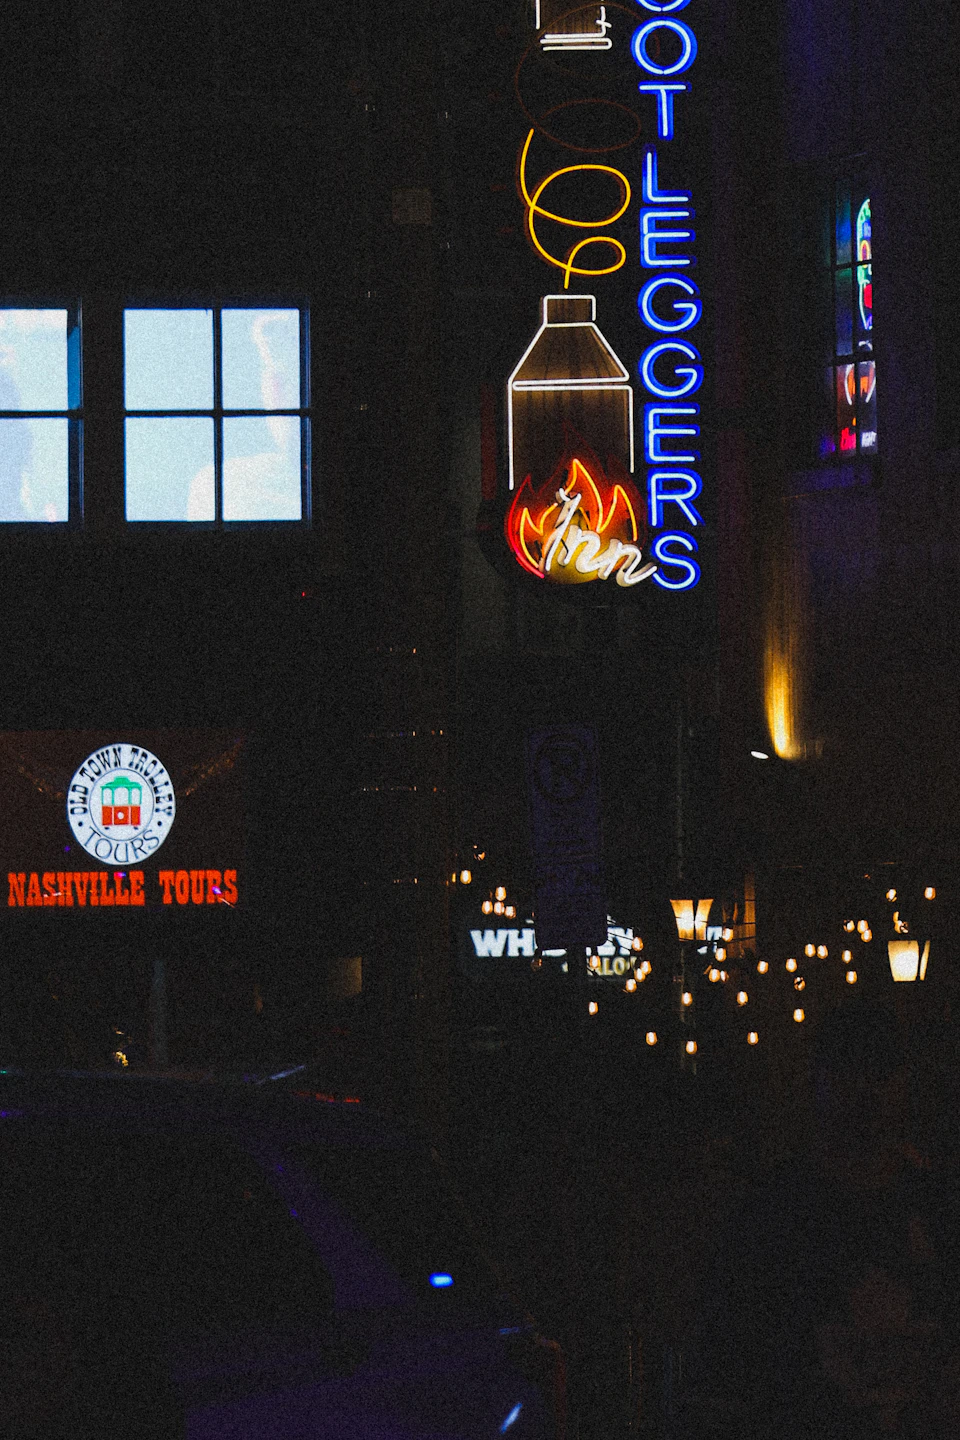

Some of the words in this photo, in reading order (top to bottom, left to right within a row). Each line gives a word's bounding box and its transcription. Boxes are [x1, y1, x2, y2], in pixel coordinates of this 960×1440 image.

[537, 487, 658, 587] Inn
[69, 784, 88, 816] OLD
[79, 746, 122, 782] TOWN
[128, 747, 173, 817] TROLLEY
[84, 825, 160, 863] TOURS
[8, 871, 146, 907] NASHVILLE
[158, 869, 239, 906] TOURS
